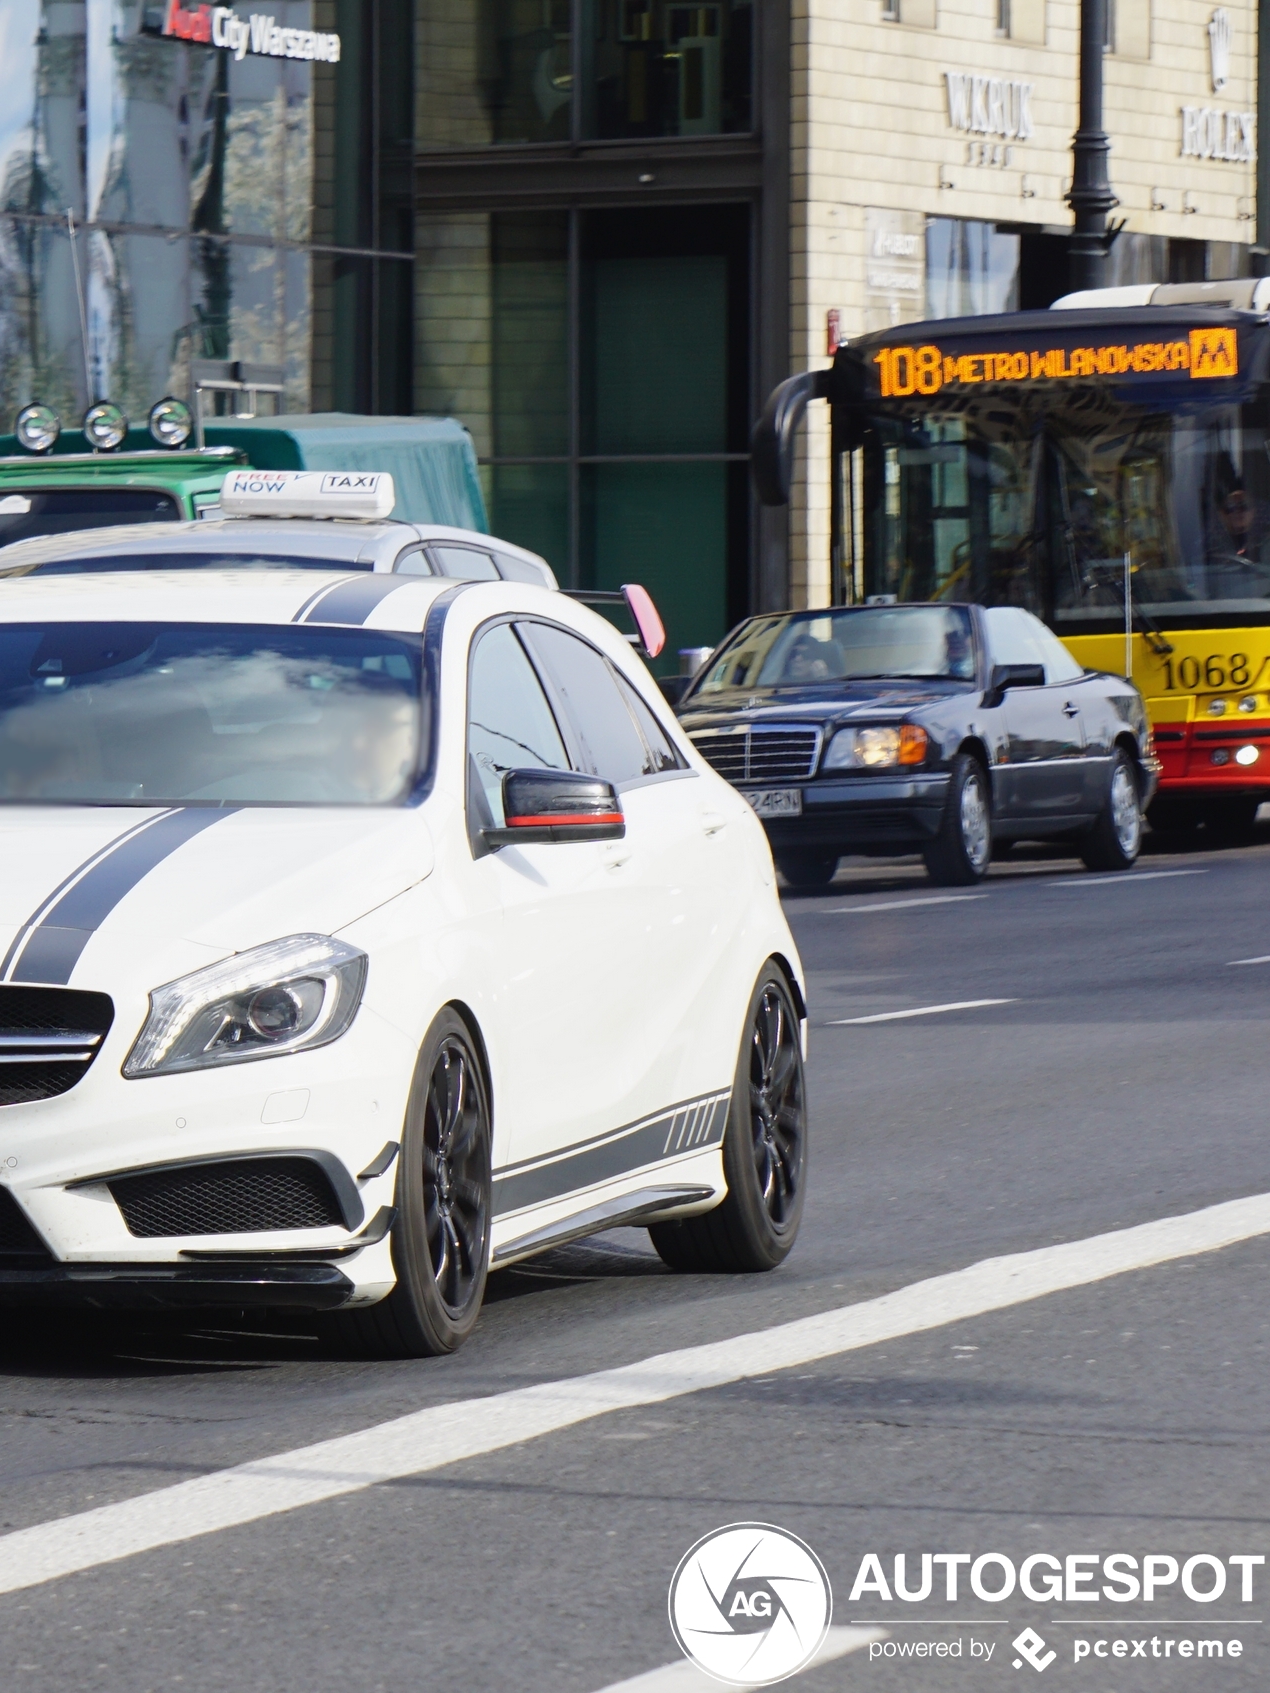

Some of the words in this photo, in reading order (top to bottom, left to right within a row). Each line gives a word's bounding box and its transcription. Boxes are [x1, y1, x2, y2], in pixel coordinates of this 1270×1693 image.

[212, 6, 250, 61] City
[250, 13, 341, 63] Warszawa
[1179, 105, 1257, 163] ROLEX
[873, 345, 943, 397] 108
[942, 351, 1029, 384] METRO
[1030, 341, 1191, 378] WILANOWSKA
[233, 481, 286, 493] NOW
[236, 473, 287, 481] FREE
[328, 475, 375, 487] TAXI
[1163, 653, 1249, 690] 1068
